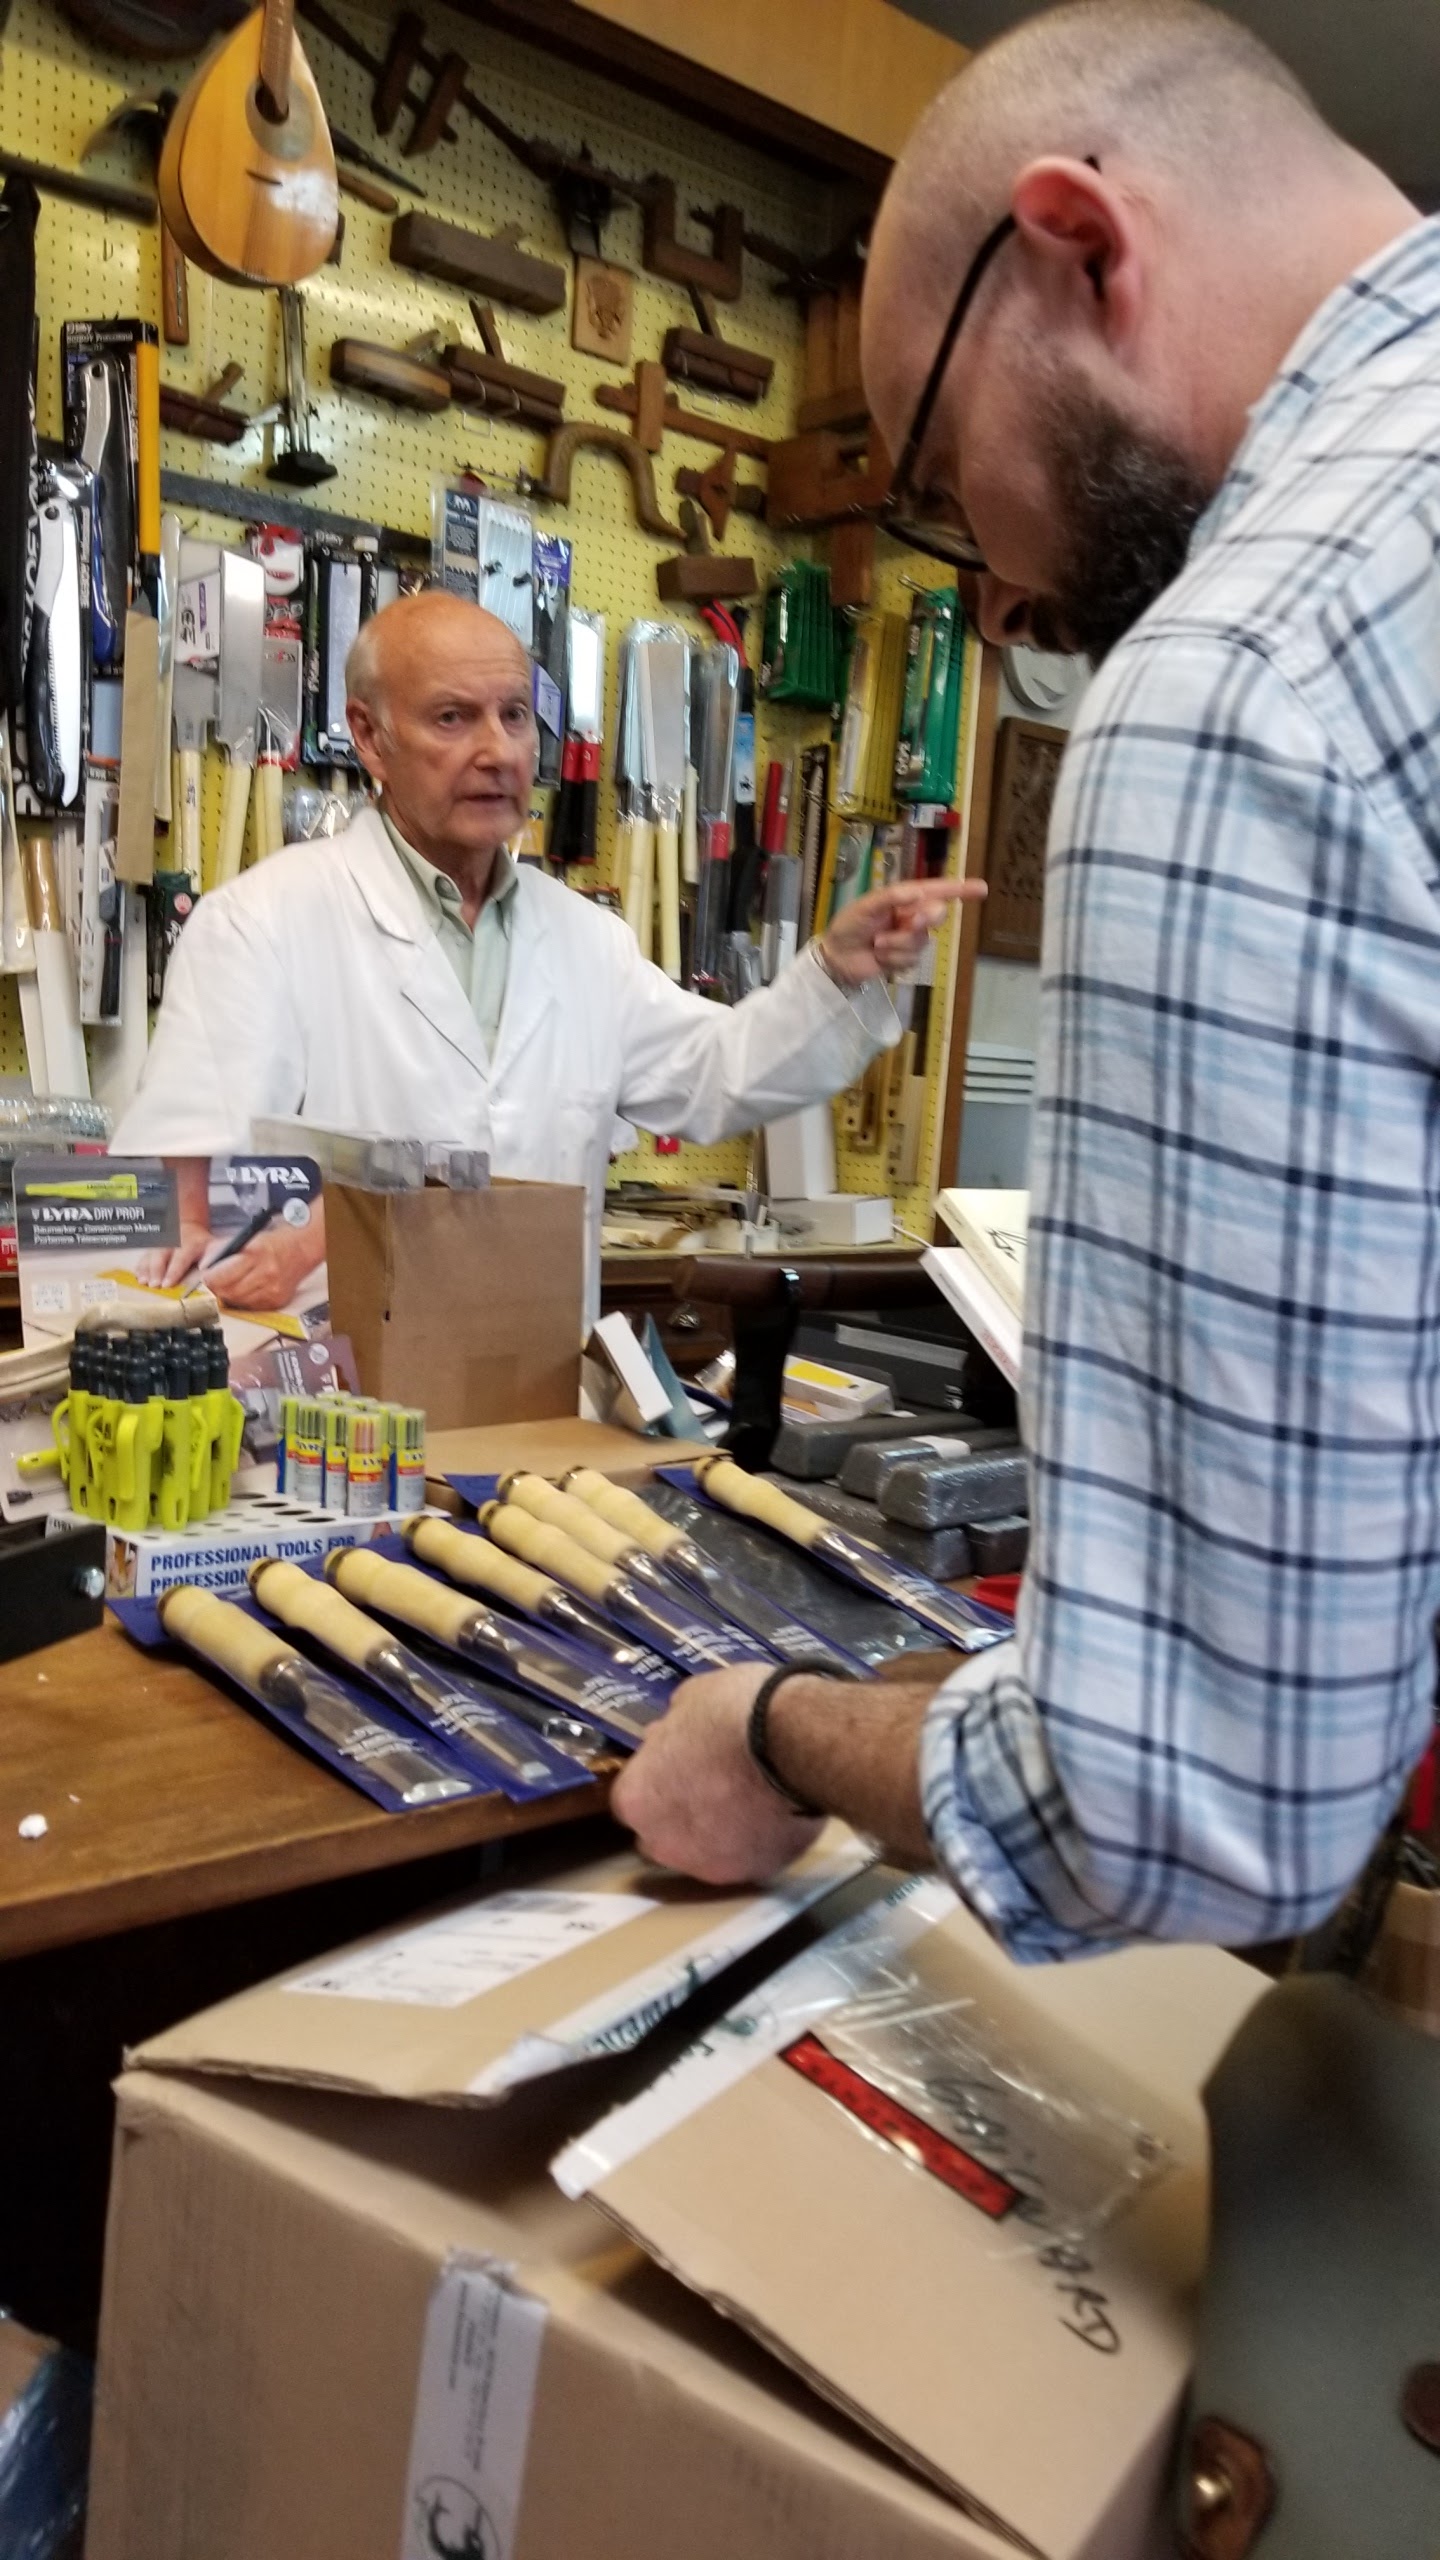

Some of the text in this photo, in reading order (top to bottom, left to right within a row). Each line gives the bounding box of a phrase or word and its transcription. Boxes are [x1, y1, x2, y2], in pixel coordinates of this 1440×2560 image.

[241, 1167, 310, 1184] LYRA
[43, 1207, 93, 1221] LYRA
[115, 1206, 145, 1221] PROFI
[151, 1535, 357, 1572] PROFESSIONAL TOOLS FOR
